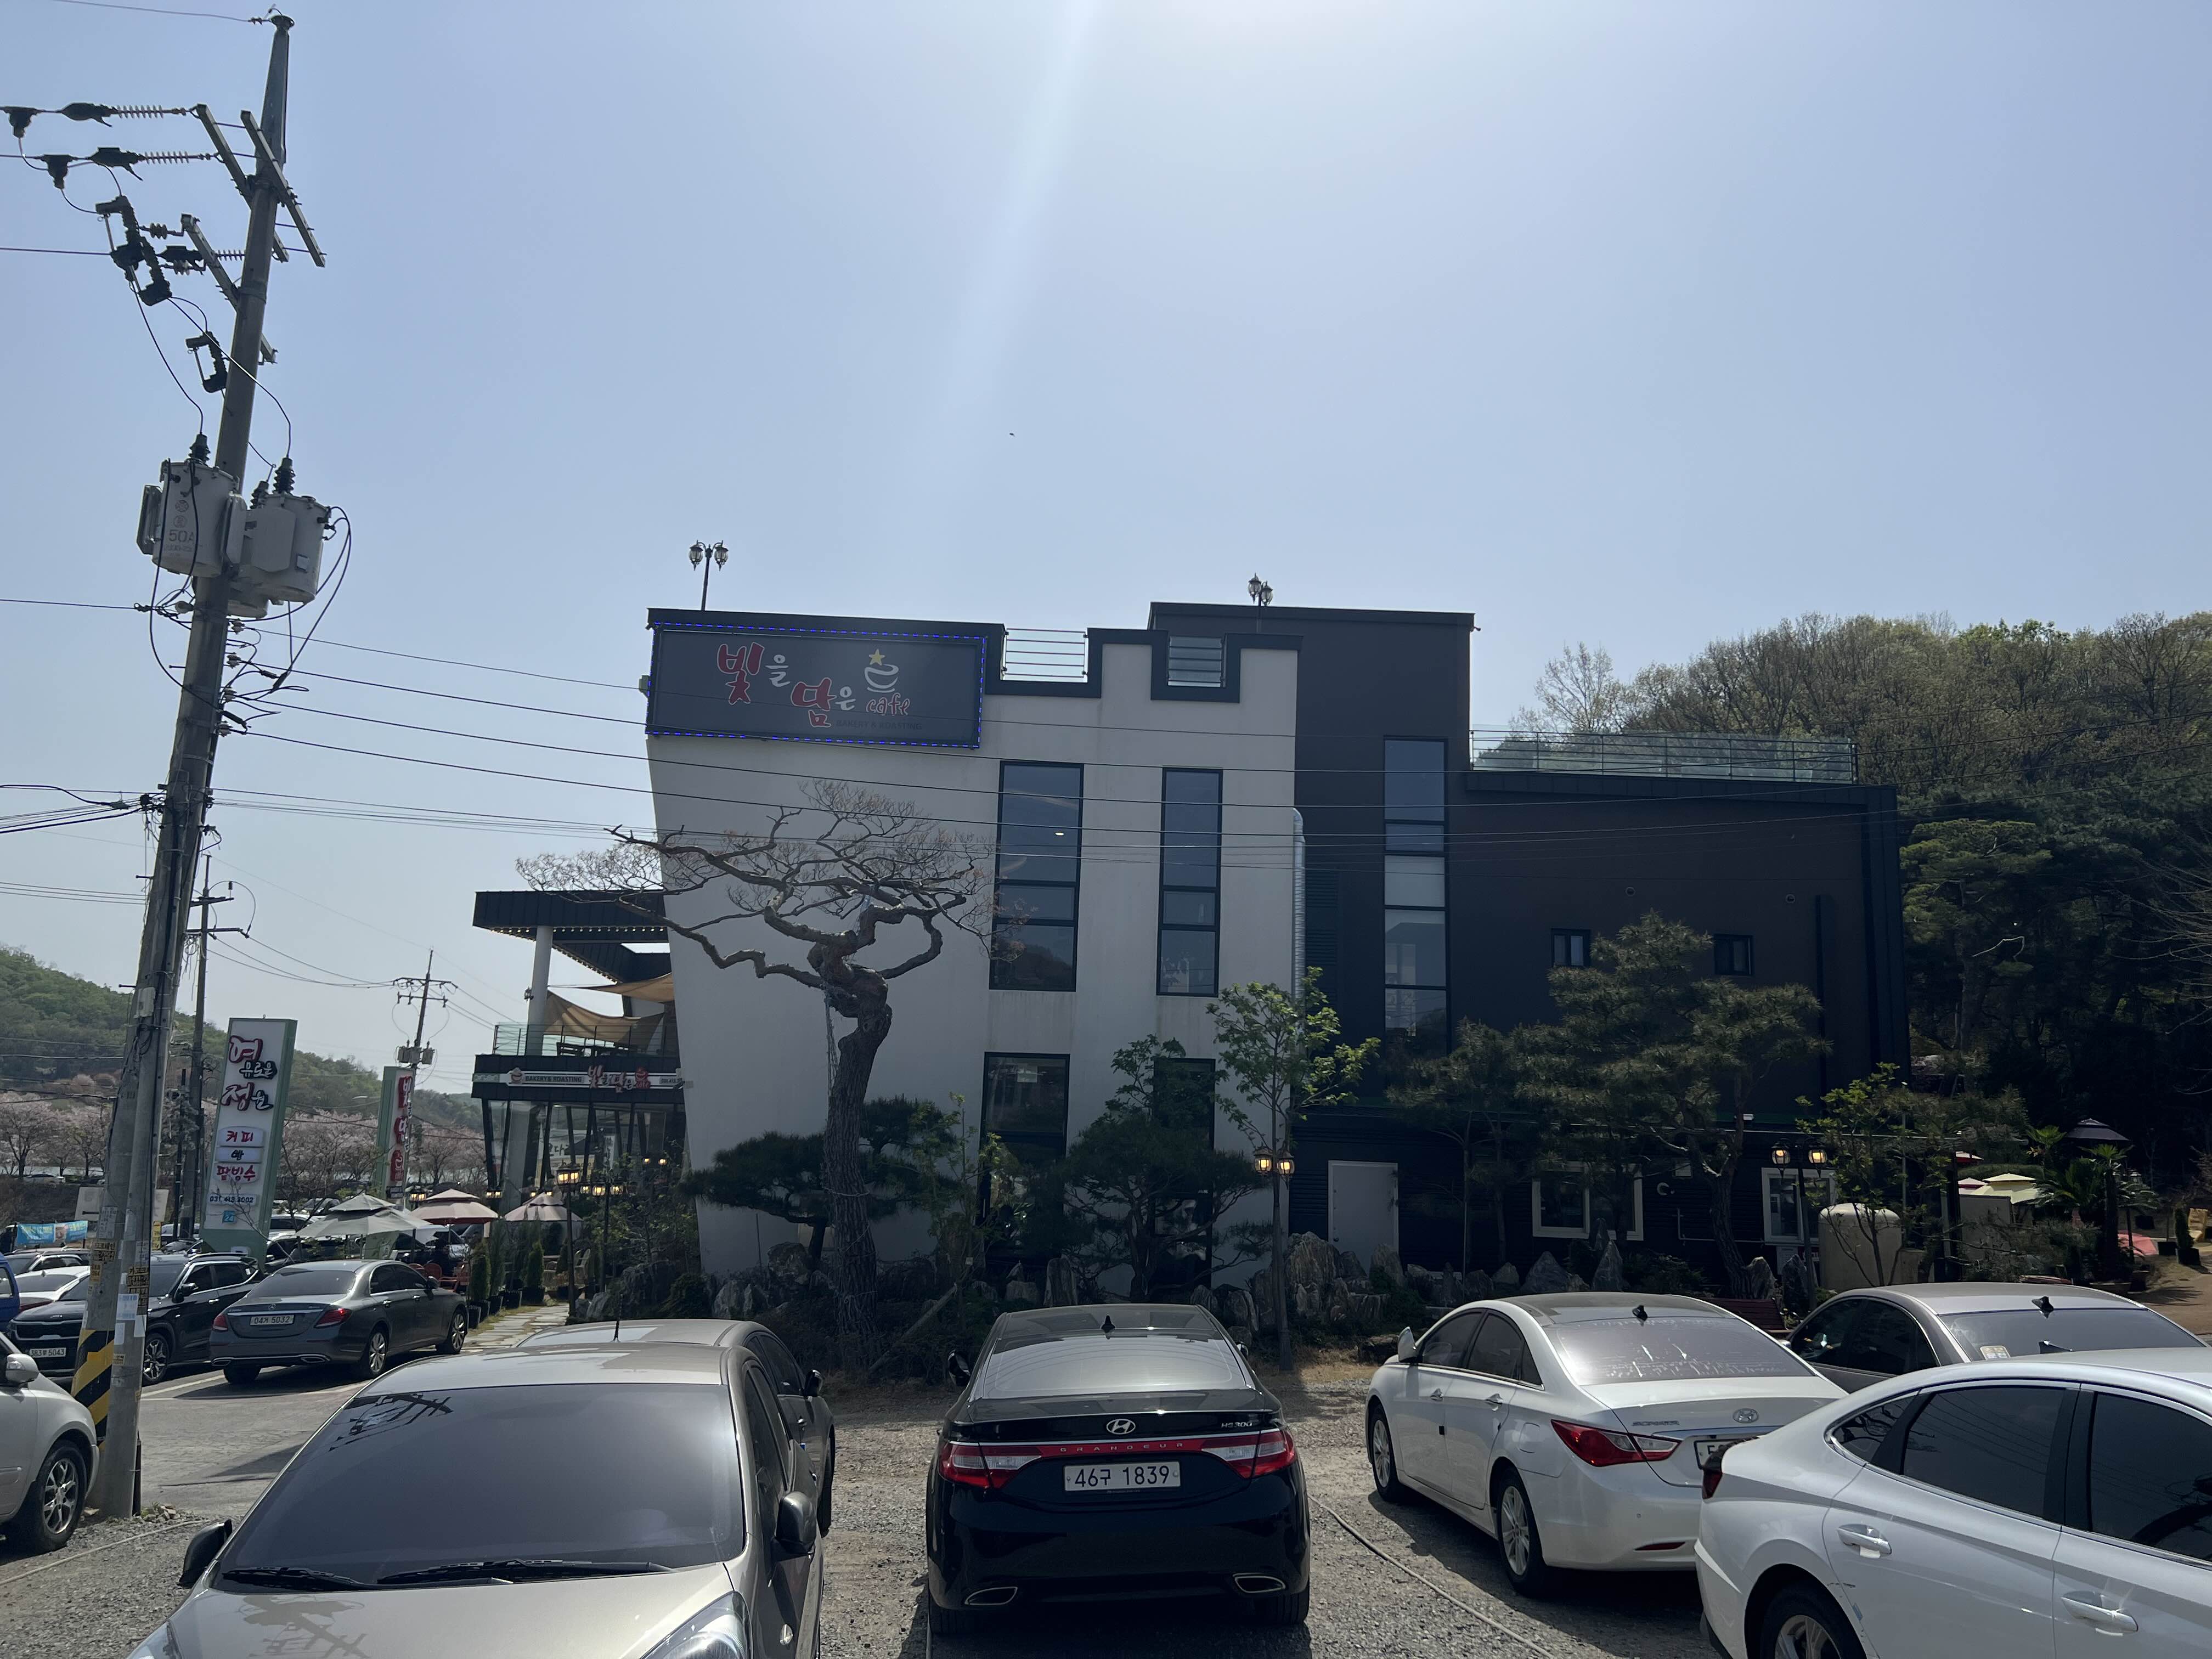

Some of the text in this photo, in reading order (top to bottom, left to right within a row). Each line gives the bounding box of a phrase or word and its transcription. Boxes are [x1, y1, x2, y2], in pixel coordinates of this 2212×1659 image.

[716, 641, 857, 728] 빛을 담은
[866, 692, 911, 716] cafe
[220, 1082, 274, 1111] 정원
[225, 1130, 253, 1142] 커피
[231, 1150, 244, 1160] 빵
[1075, 1465, 1170, 1487] 46구 1839
